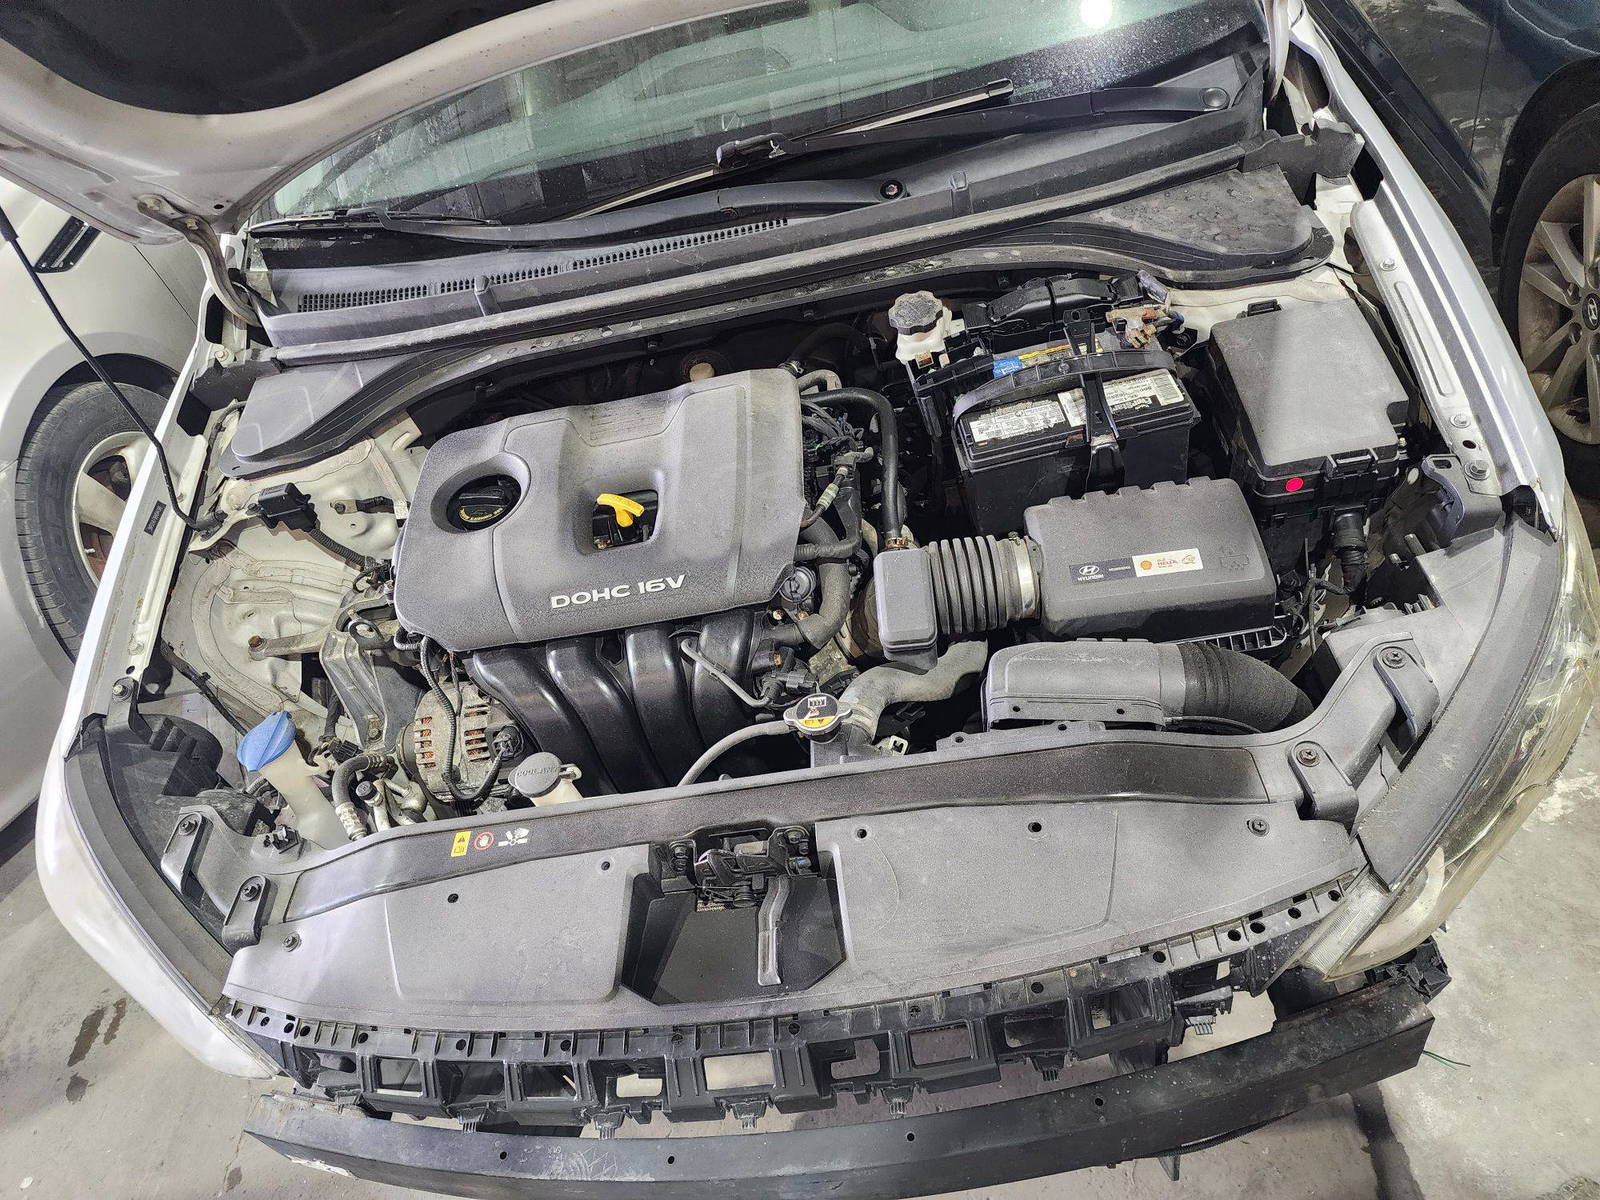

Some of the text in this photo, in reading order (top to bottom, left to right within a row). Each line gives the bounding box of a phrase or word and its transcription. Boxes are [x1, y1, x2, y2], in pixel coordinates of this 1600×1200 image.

[1077, 573, 1105, 582] HYUNDAI
[551, 574, 685, 609] DOHC 16V
